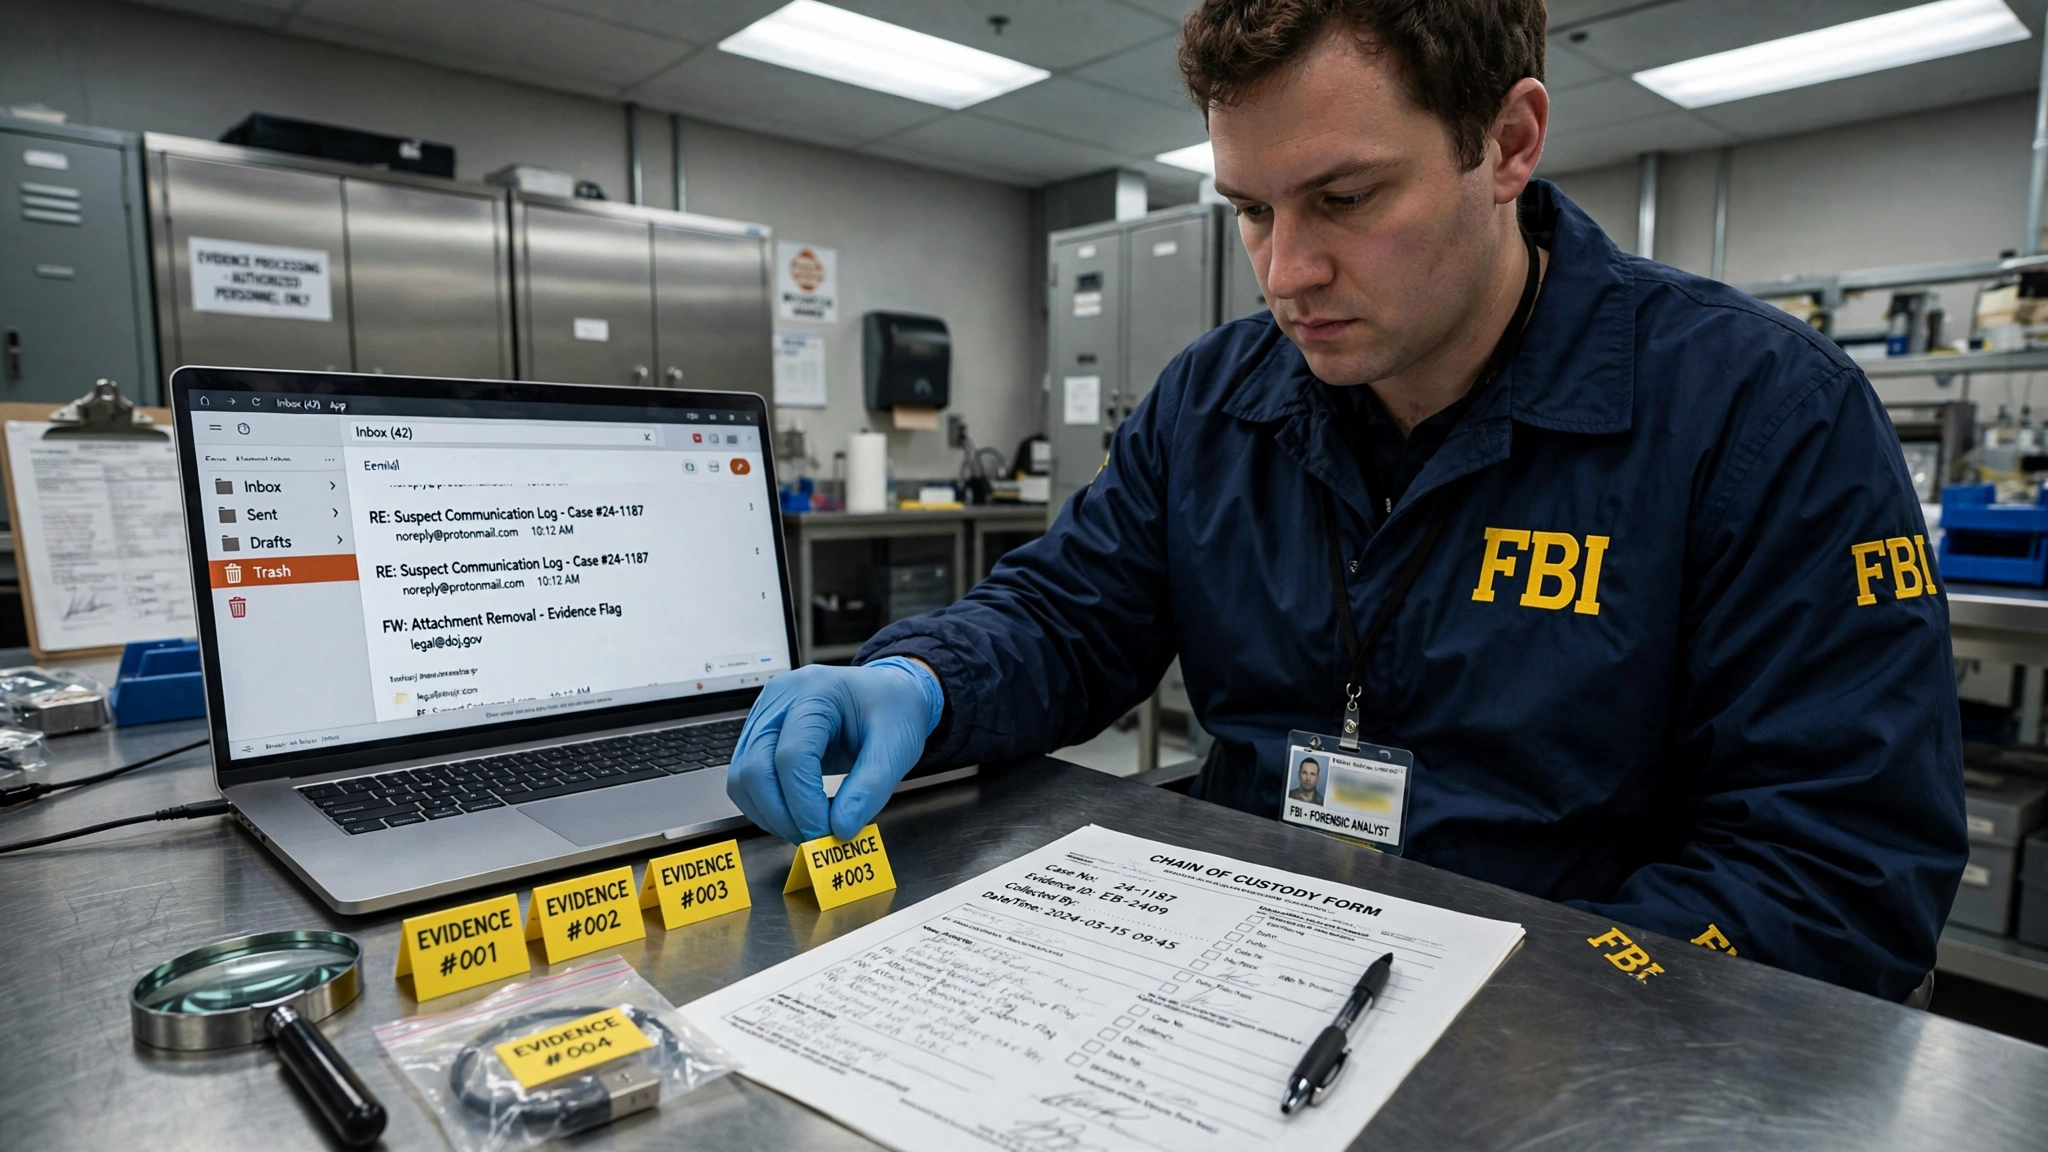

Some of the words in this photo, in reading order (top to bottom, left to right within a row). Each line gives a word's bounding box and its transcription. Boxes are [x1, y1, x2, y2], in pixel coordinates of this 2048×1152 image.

[355, 426, 388, 439] Inbox
[390, 427, 413, 441] (42)
[244, 480, 282, 493] Inbox
[247, 508, 278, 522] Sent
[369, 511, 391, 524] RE:
[394, 510, 442, 526] Suspect
[445, 508, 535, 521] Communication
[537, 507, 558, 521] Log
[567, 506, 594, 518] Case
[596, 505, 644, 517] #24-1187
[250, 536, 292, 549] Drafts
[396, 527, 519, 543] noreply@protonmail.com
[531, 526, 556, 536] 10:12
[559, 525, 574, 535] AM
[253, 565, 291, 578] Trash
[376, 565, 397, 578] RE:
[400, 563, 449, 579] Suspect
[451, 558, 540, 574] Communication
[542, 557, 563, 571] Log
[573, 555, 599, 567] Case
[601, 552, 649, 565] #24-1187
[1471, 526, 1610, 616] FBI
[1851, 534, 1938, 607] FBI
[403, 579, 525, 597] noreply@protonmail.com
[537, 575, 562, 586] 10:12
[565, 574, 580, 585] AM
[382, 619, 408, 633] FW:
[411, 614, 483, 631] Attachment
[486, 608, 536, 624] Removal
[548, 605, 597, 620] Evidence
[599, 603, 622, 617] Flag
[410, 635, 483, 652] legal@doj.gov
[1289, 805, 1303, 819] FBI
[1309, 810, 1350, 829] FORENSIC
[1351, 820, 1390, 838] ANALYST
[812, 836, 879, 869] EVIDENCE
[661, 852, 736, 886] EVIDENCE
[831, 863, 875, 891] #003
[1045, 864, 1075, 876] Case
[1113, 882, 1178, 903] 24-1187
[546, 879, 630, 917] EVIDENCE
[680, 880, 729, 910] #003
[1005, 882, 1060, 900] Collected
[1058, 895, 1080, 907] By:
[1024, 872, 1076, 892] Evidence
[1077, 886, 1096, 896] ID:
[1098, 891, 1169, 915] EB-2409
[1149, 854, 1204, 872] CHAIN
[1205, 867, 1233, 878] OF
[1233, 874, 1322, 901] CUSTODY
[1322, 896, 1383, 917] FORM
[417, 908, 513, 951] EVIDENCE
[567, 909, 621, 942] #002
[1044, 908, 1131, 936] 2024-03-15
[1132, 932, 1180, 950] 09:45
[440, 942, 498, 978] #001
[512, 1016, 622, 1058] EVIDENCE
